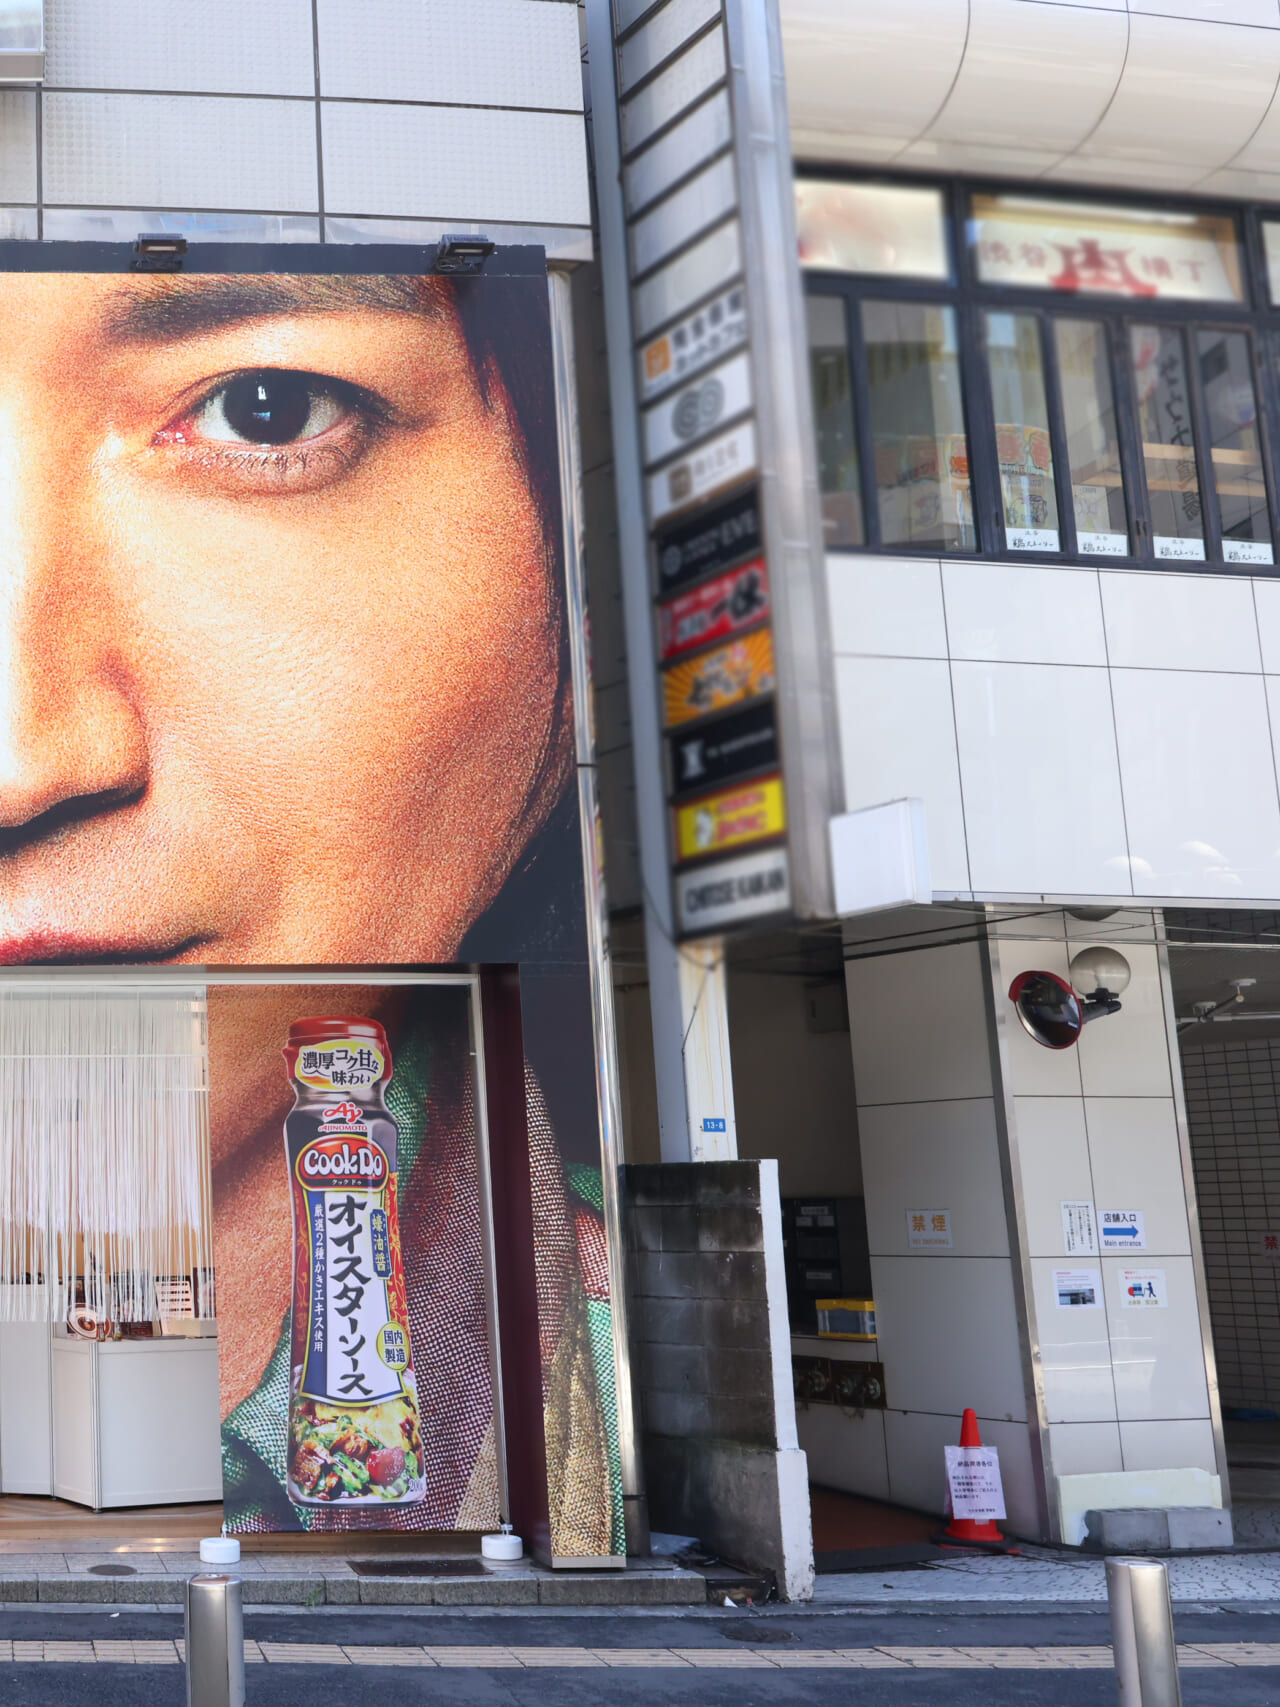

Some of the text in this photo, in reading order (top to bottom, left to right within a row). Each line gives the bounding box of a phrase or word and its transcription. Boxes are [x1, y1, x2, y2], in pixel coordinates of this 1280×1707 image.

[331, 1070, 371, 1086] 味わい
[318, 1124, 368, 1132] AJINOMOTO
[1103, 1213, 1137, 1223] 店舗入口
[328, 1194, 373, 1396] オイスターソース
[383, 1330, 404, 1345] 国内
[384, 1348, 406, 1363] 製造
